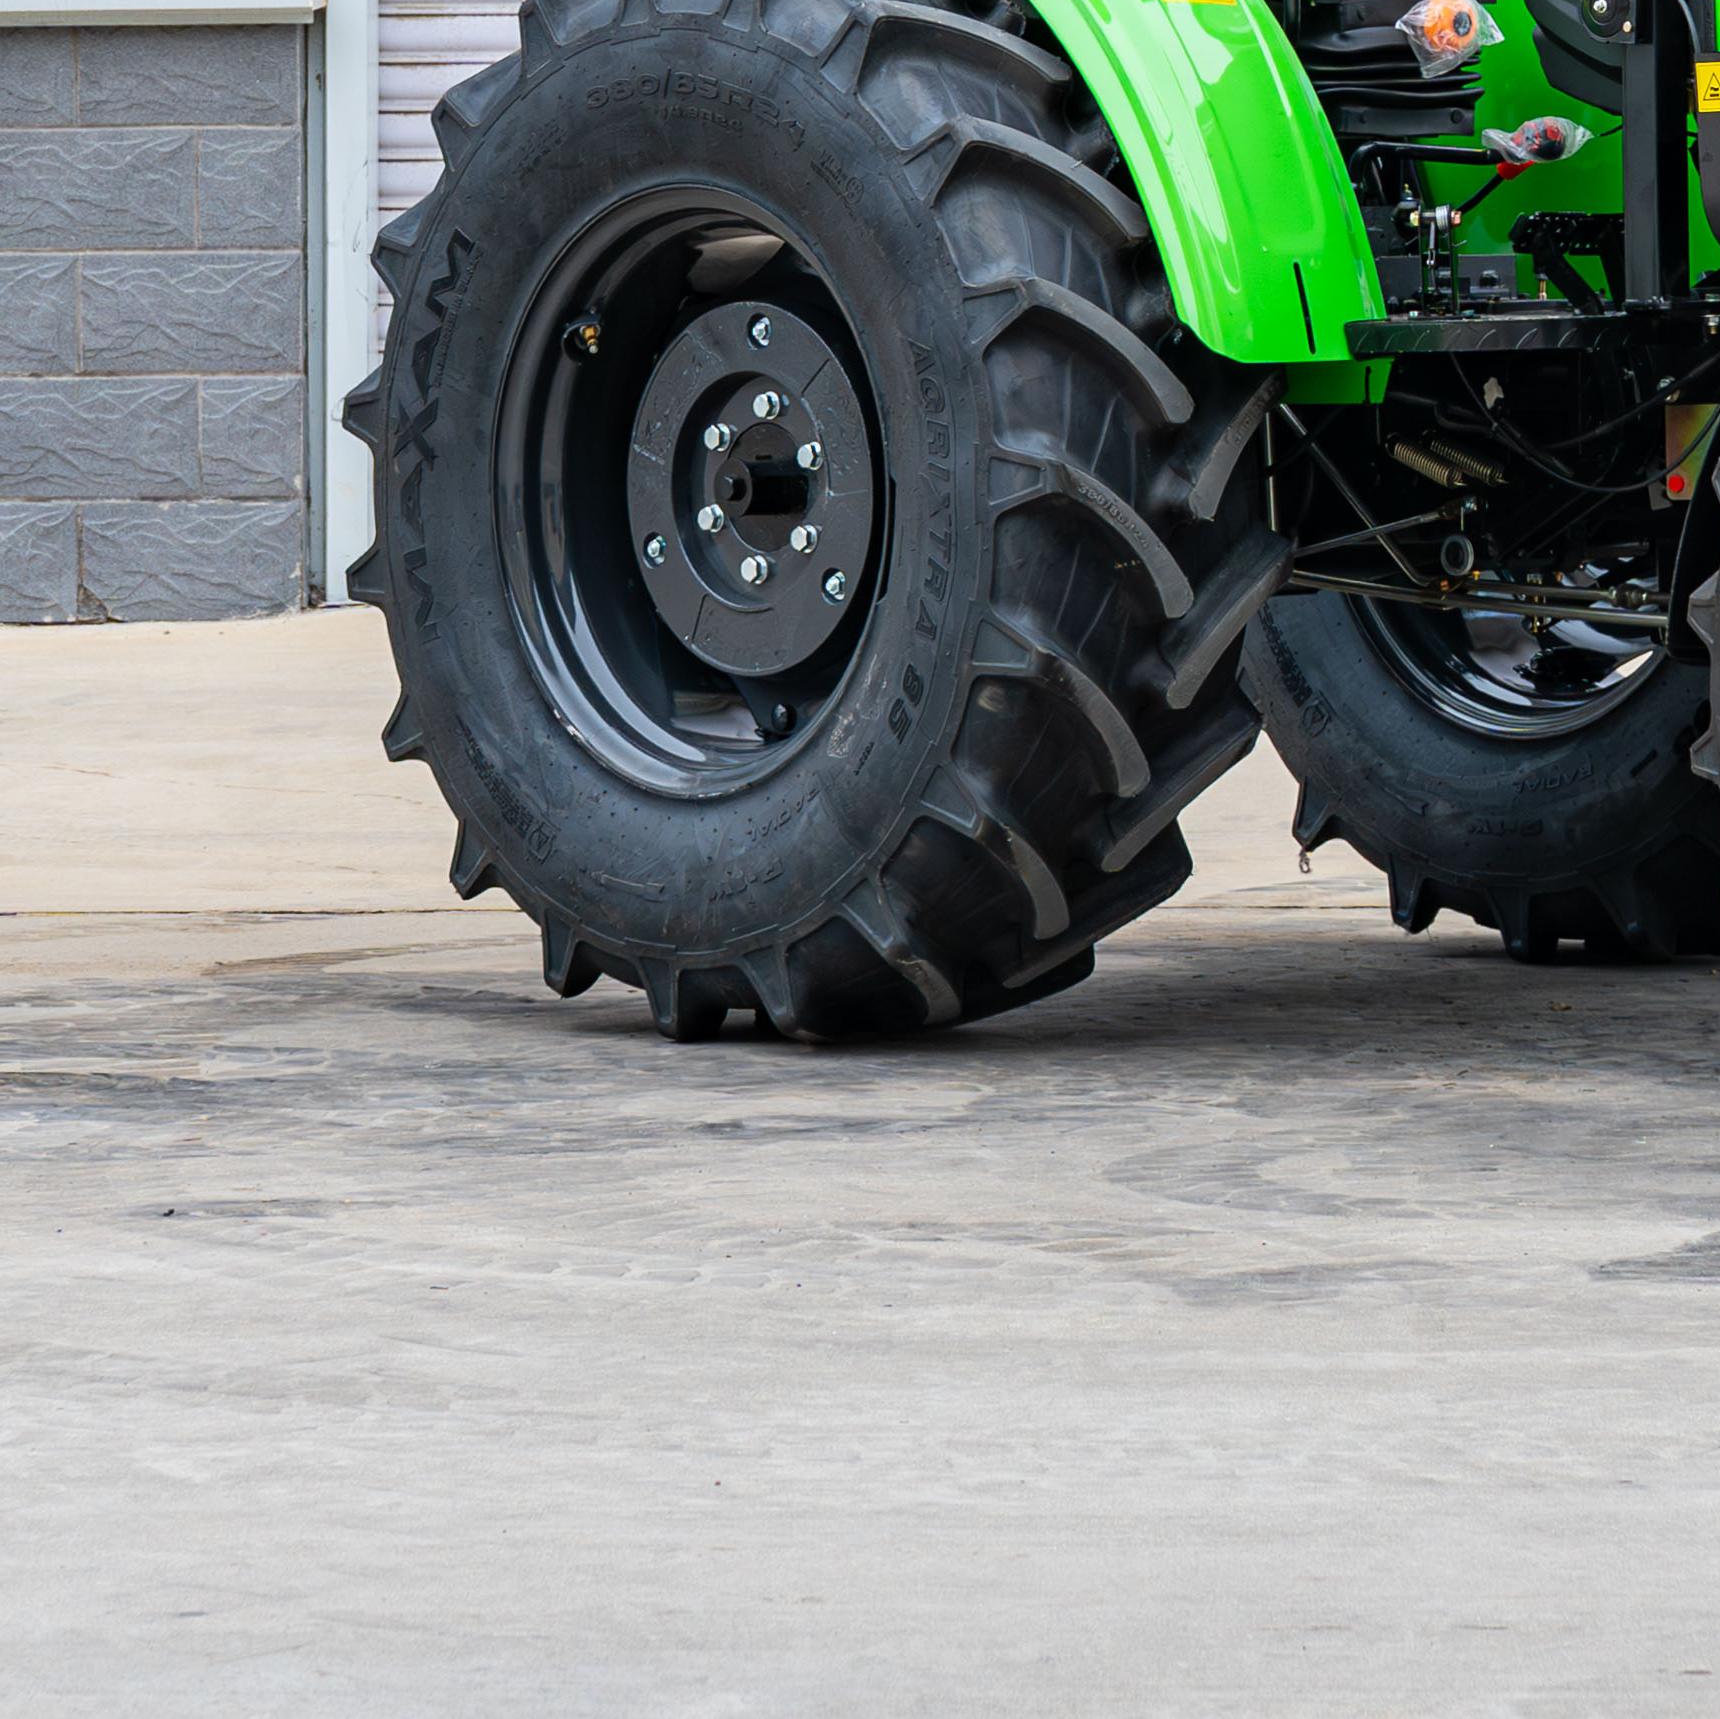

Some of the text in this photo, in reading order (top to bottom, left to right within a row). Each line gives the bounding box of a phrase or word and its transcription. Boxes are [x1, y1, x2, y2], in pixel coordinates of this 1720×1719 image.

[393, 225, 478, 647] MAXAM
[888, 336, 953, 745] AGRIXTRA 85
